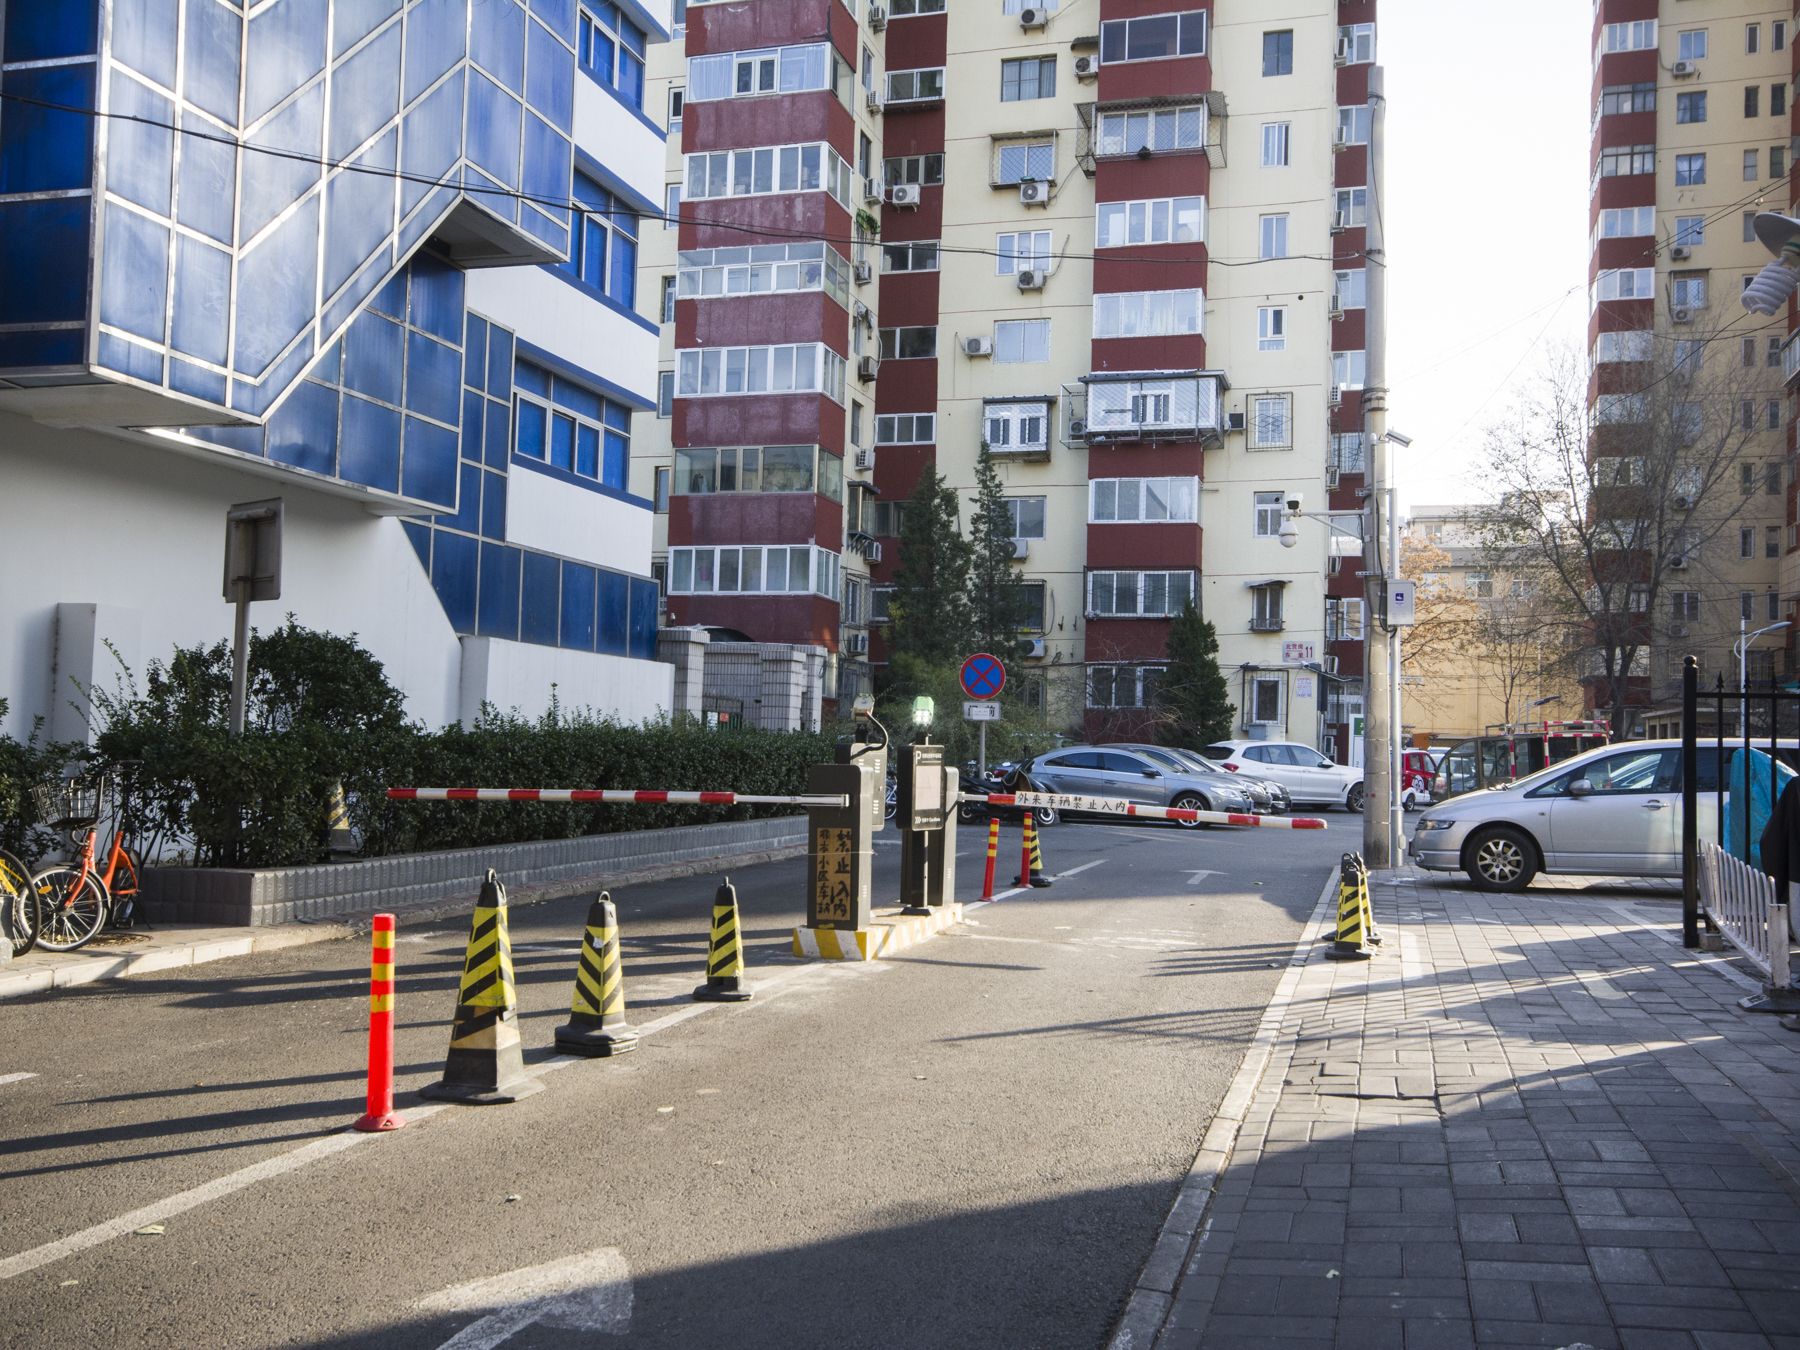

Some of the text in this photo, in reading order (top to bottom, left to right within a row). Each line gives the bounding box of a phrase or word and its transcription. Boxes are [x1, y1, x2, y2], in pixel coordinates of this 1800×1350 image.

[1305, 646, 1313, 658] 11
[1018, 793, 1126, 813] 外来车辆禁止入内
[834, 829, 850, 917] 禁止入内
